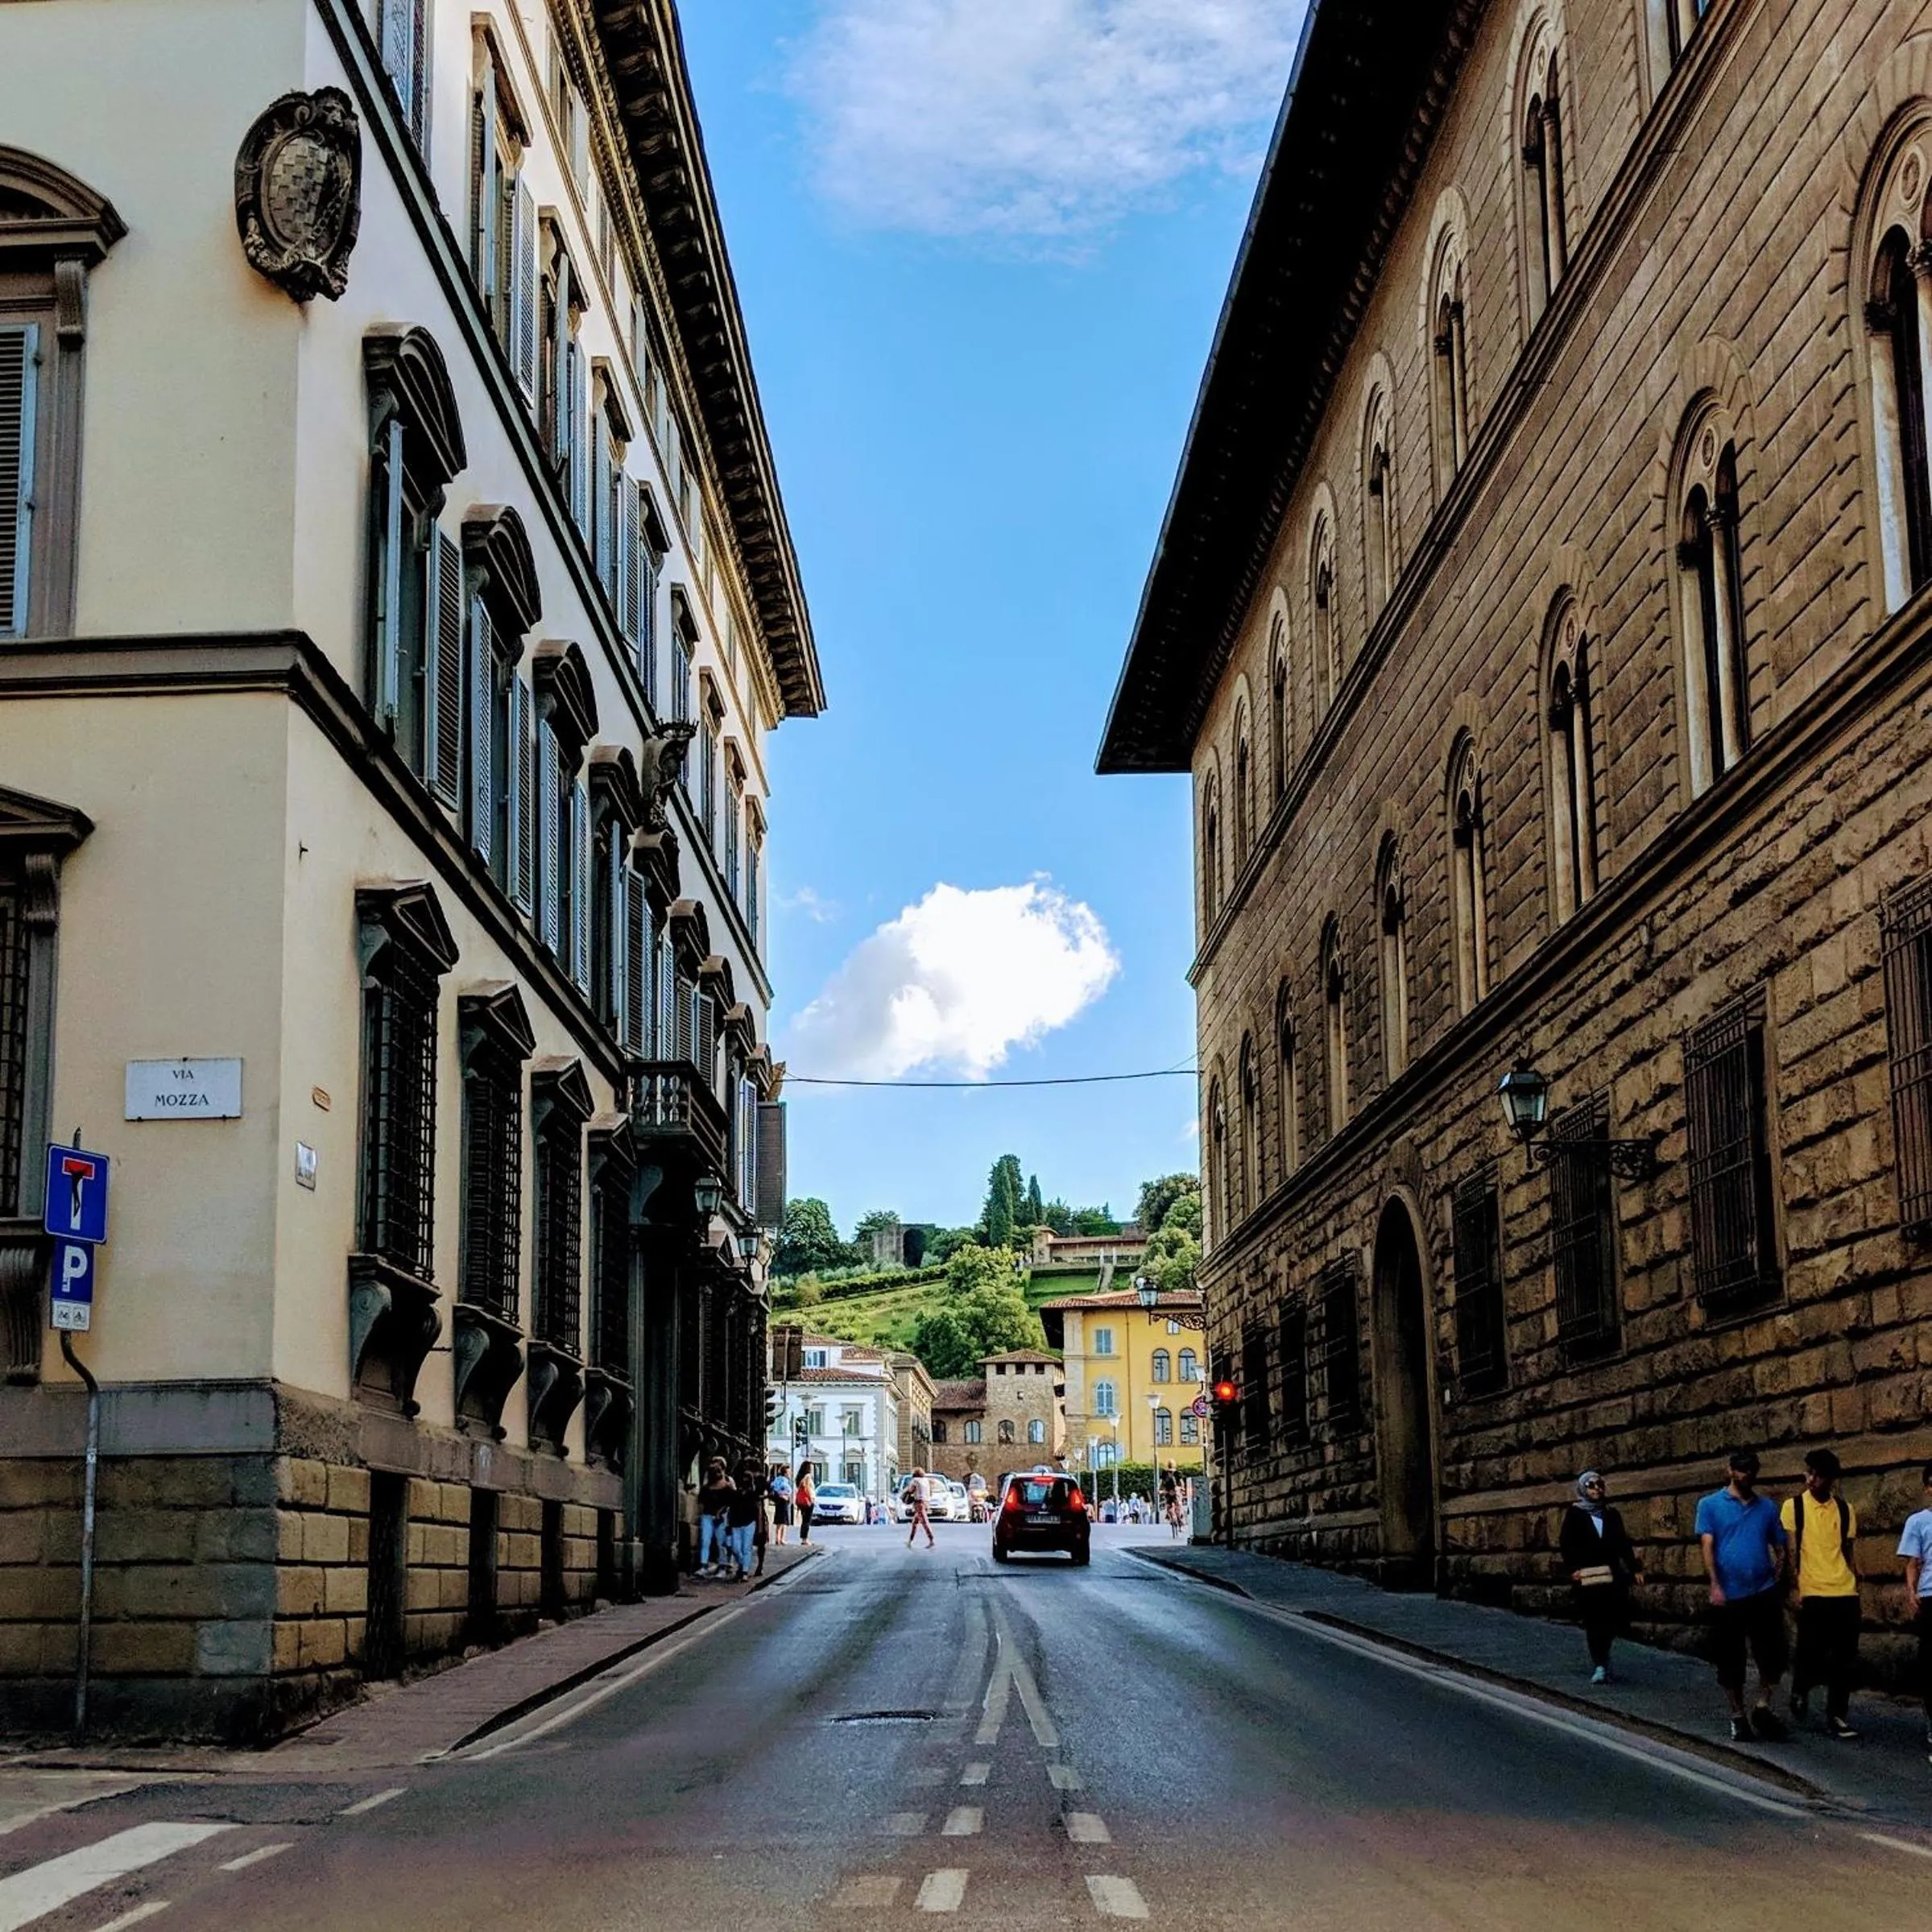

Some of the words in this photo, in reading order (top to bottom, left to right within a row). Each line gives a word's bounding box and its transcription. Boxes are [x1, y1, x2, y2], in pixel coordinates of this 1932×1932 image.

[172, 1069, 194, 1079] VIA
[155, 1094, 209, 1107] MOZZA
[61, 1245, 88, 1293] P
